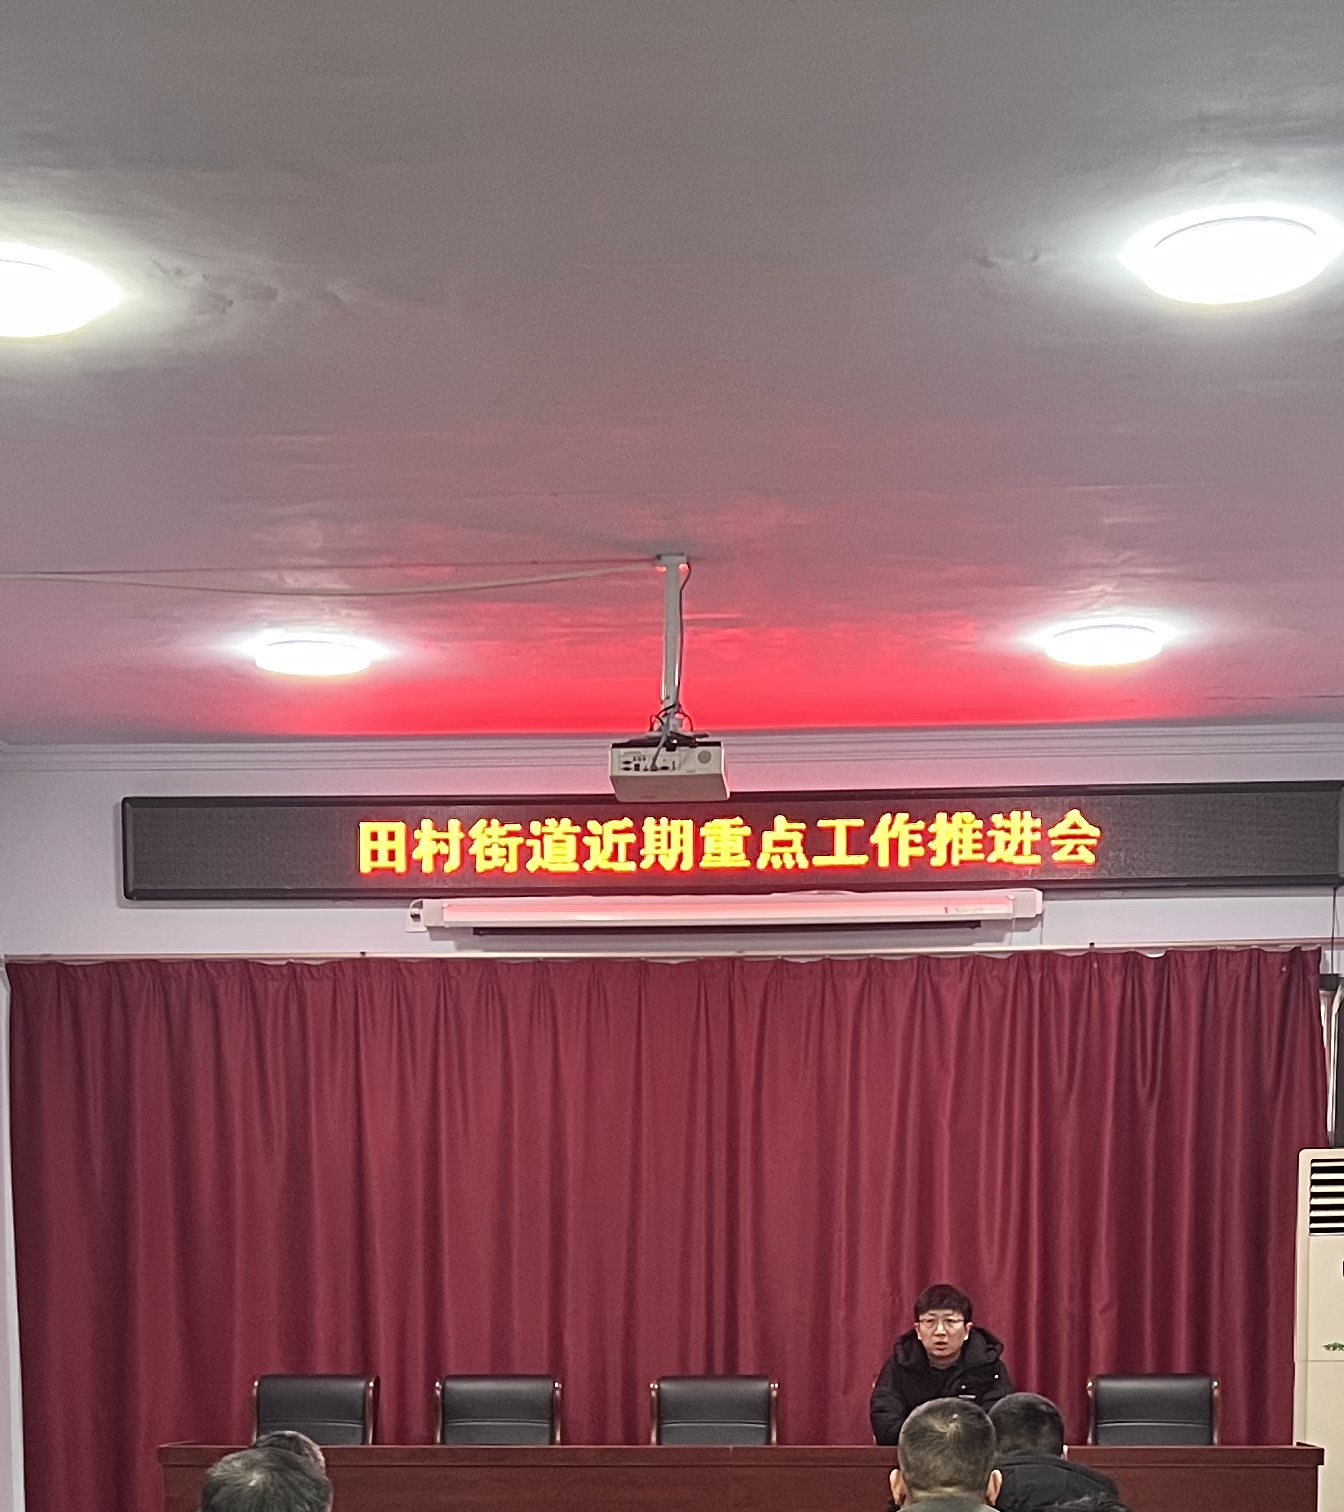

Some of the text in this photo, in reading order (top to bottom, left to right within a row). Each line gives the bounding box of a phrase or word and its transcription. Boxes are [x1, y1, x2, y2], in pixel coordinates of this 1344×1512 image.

[358, 808, 1102, 874] 田村街道近期重点工作推进会
